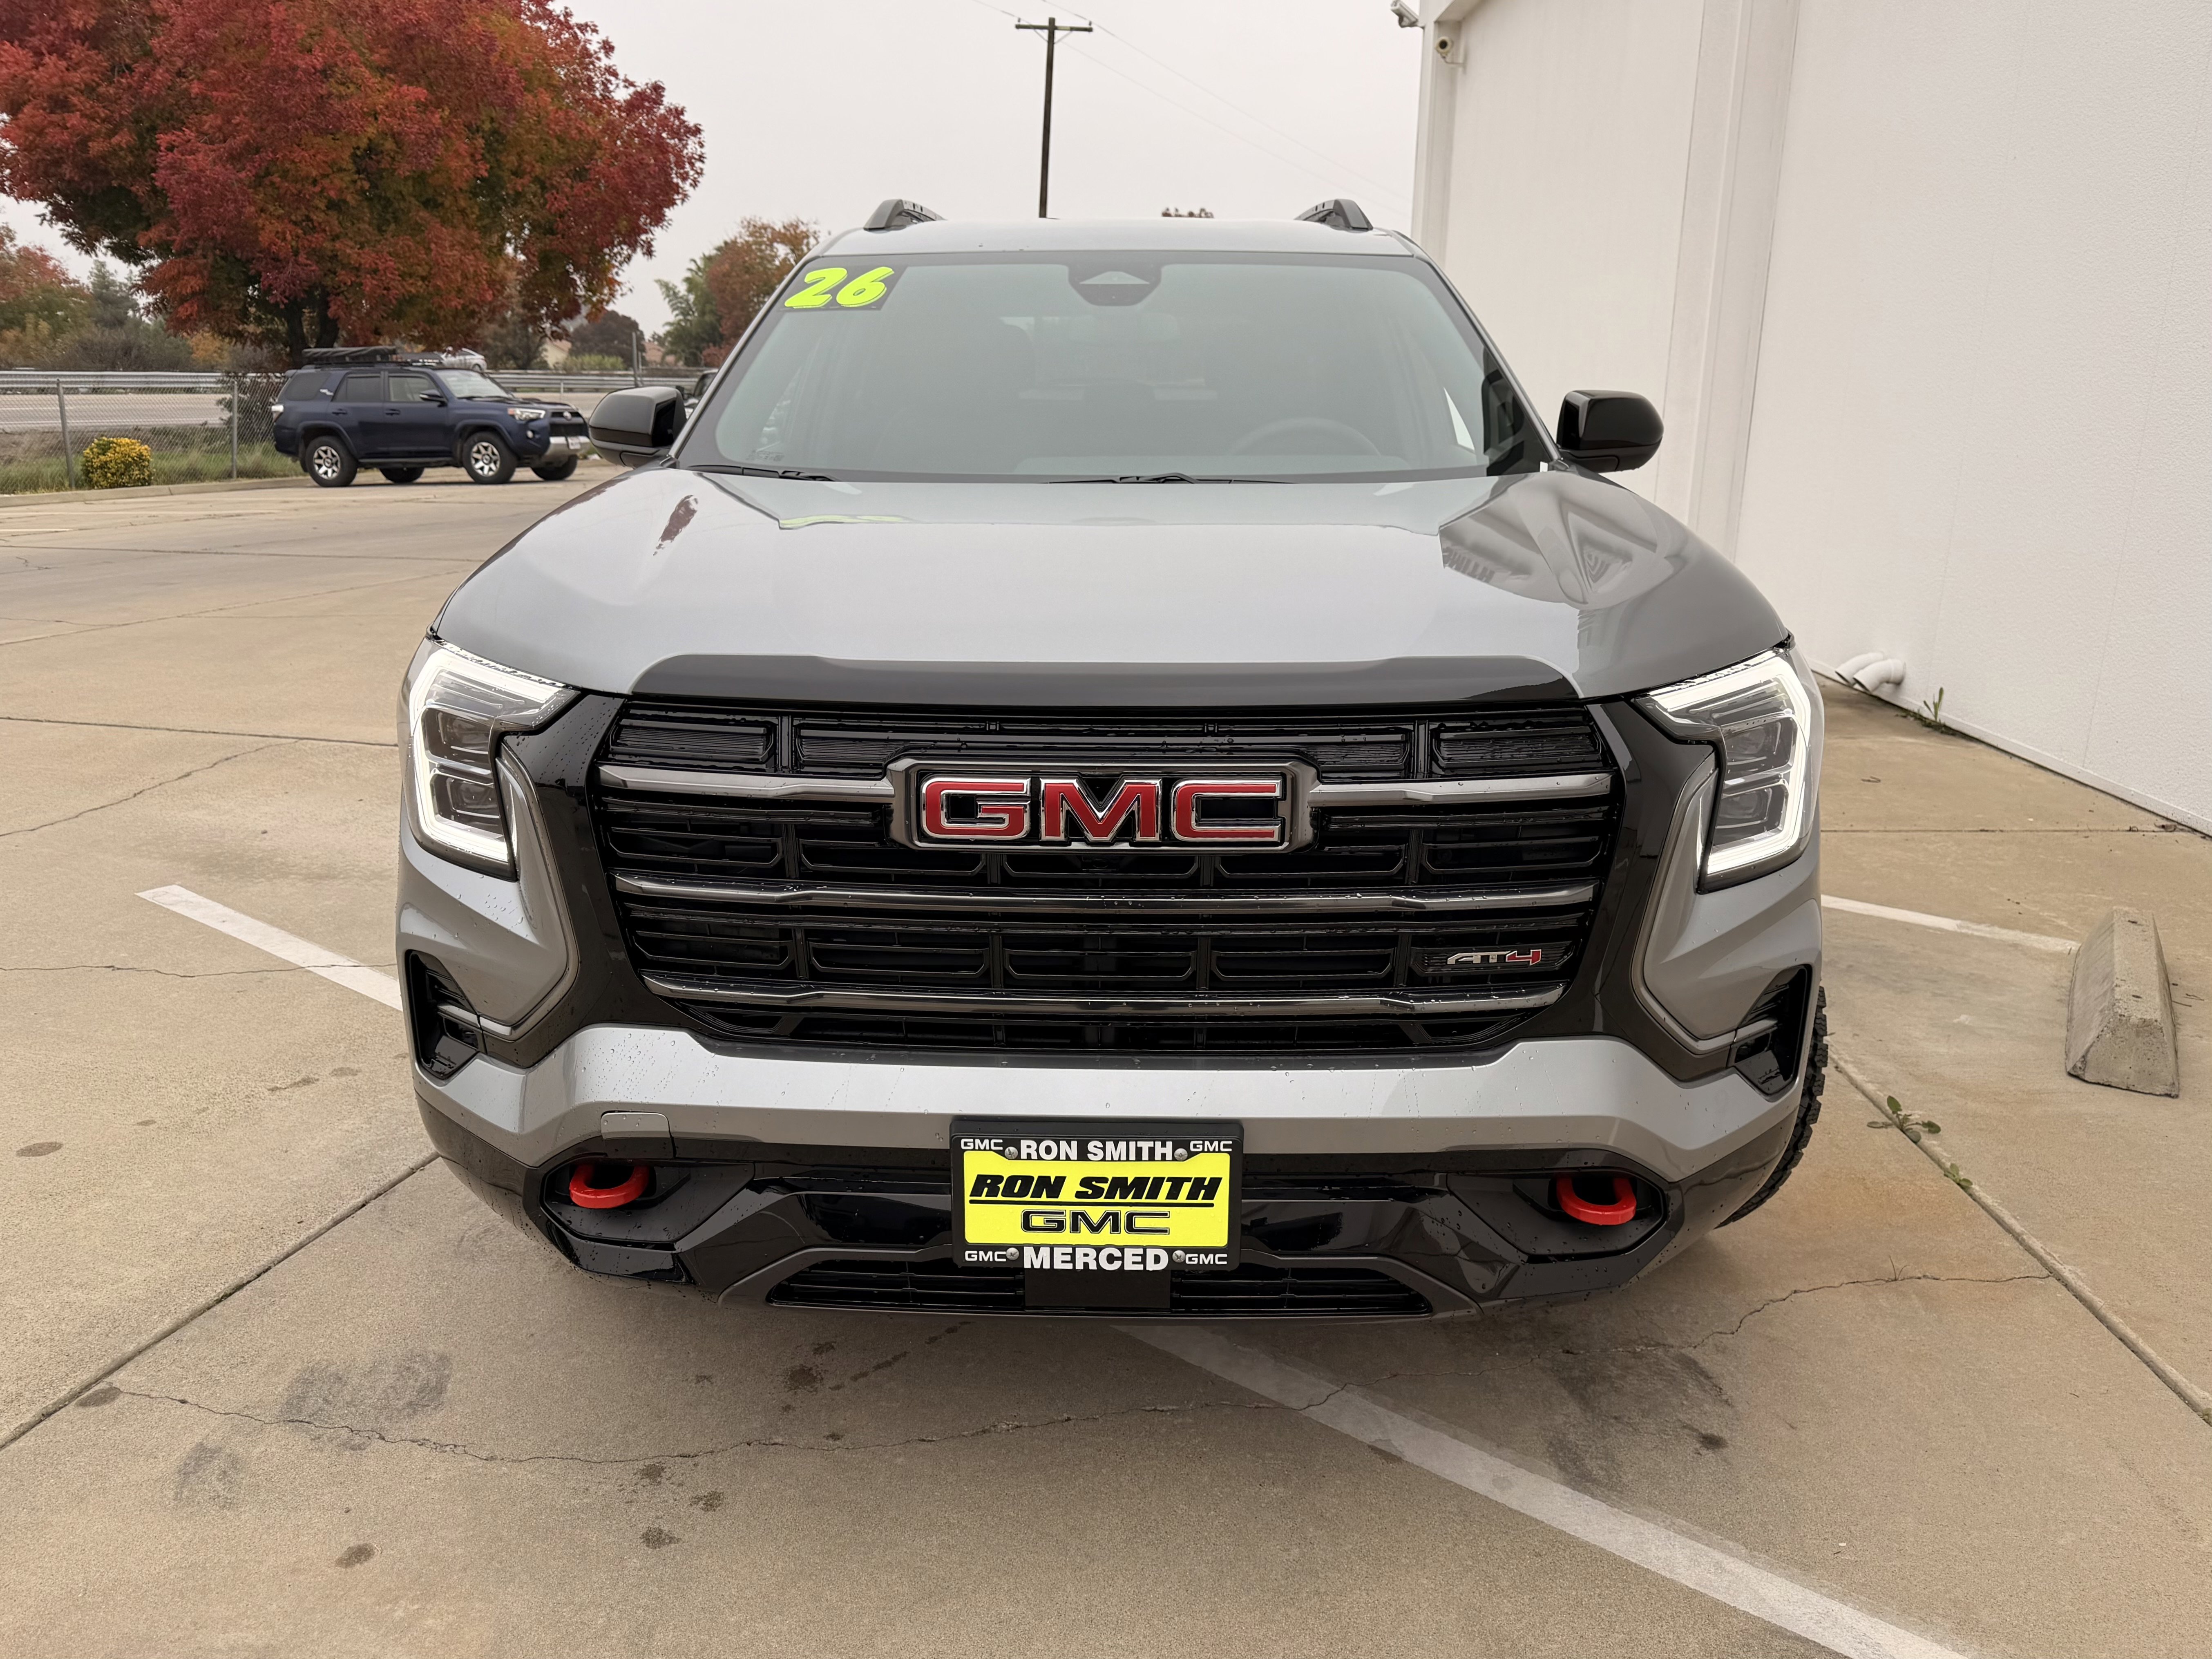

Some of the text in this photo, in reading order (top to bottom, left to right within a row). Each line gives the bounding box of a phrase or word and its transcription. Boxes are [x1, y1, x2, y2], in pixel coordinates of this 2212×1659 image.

[784, 266, 895, 309] 26
[920, 776, 1282, 842] GMC
[1447, 949, 1542, 966] AT4
[961, 1138, 1003, 1150] GMC
[1020, 1140, 1173, 1161] RON SMITH
[1190, 1140, 1232, 1152] GMC
[970, 1174, 1222, 1201] RON SMITH
[1021, 1210, 1170, 1235] GMC
[965, 1250, 1007, 1262] GMC
[1023, 1247, 1169, 1271] MERCED
[1185, 1253, 1227, 1264] GMC
